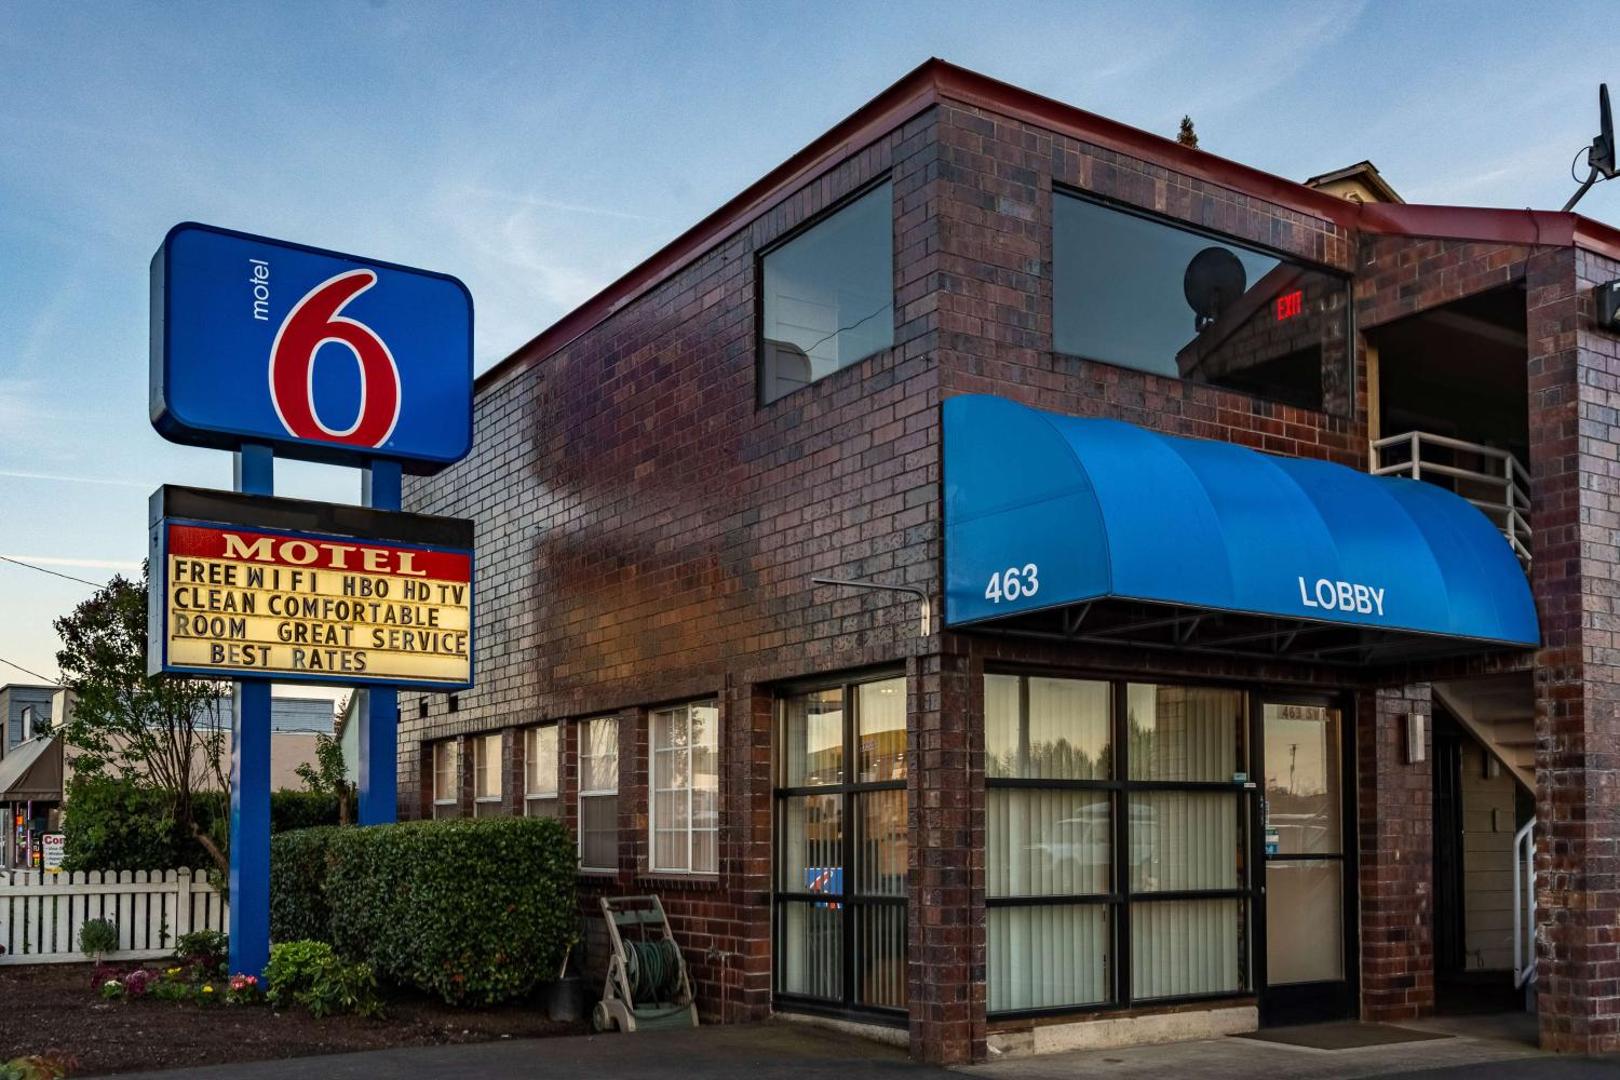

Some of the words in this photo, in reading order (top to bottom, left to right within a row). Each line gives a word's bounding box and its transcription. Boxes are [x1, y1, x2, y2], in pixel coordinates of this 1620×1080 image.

[250, 259, 268, 321] motel
[1277, 290, 1302, 321] EXIT
[268, 268, 401, 448] 6
[222, 533, 427, 576] MOTEL
[174, 560, 237, 586] FREE
[343, 575, 389, 598] HBO
[985, 563, 1039, 604] 463
[1298, 576, 1386, 616] LOBBY
[174, 587, 255, 613] CLEAN
[268, 594, 439, 627] COMFORTABLE
[174, 613, 246, 639] ROOM
[277, 620, 354, 646] GREAT
[372, 628, 467, 654] SERVICE
[210, 642, 271, 666] BEST
[292, 647, 367, 672] RATES
